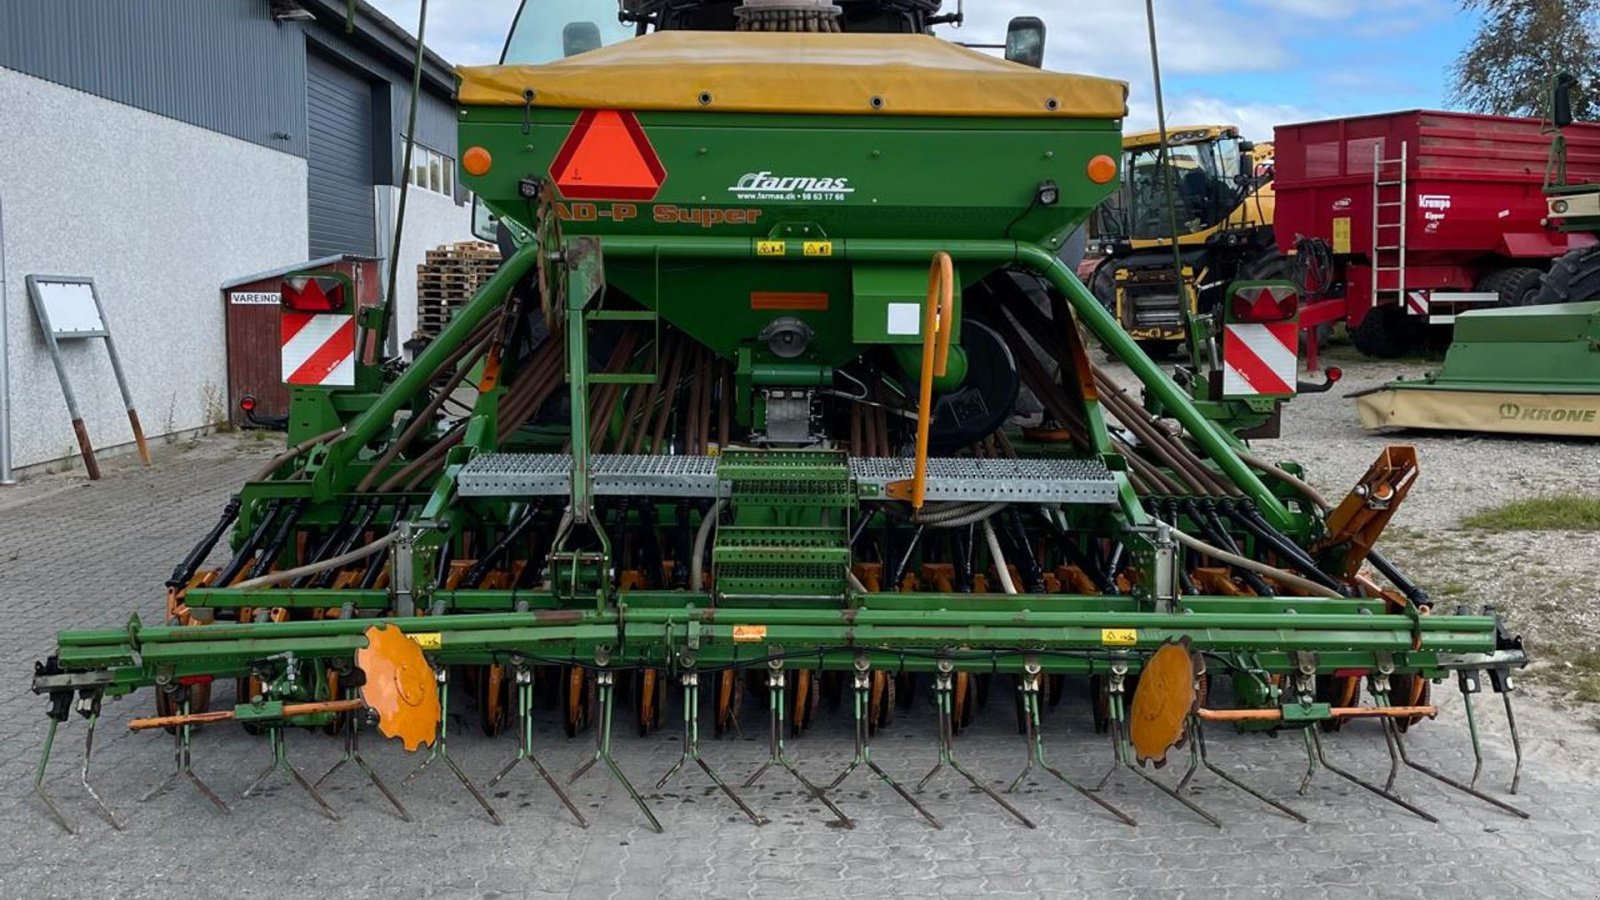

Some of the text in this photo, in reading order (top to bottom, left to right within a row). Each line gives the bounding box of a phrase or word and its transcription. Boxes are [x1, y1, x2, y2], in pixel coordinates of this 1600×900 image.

[737, 192, 796, 201] www.farmas.dk
[824, 192, 834, 201] 17
[653, 205, 762, 227] Super
[233, 294, 281, 303] VAREIND
[1522, 408, 1597, 422] KRONE
